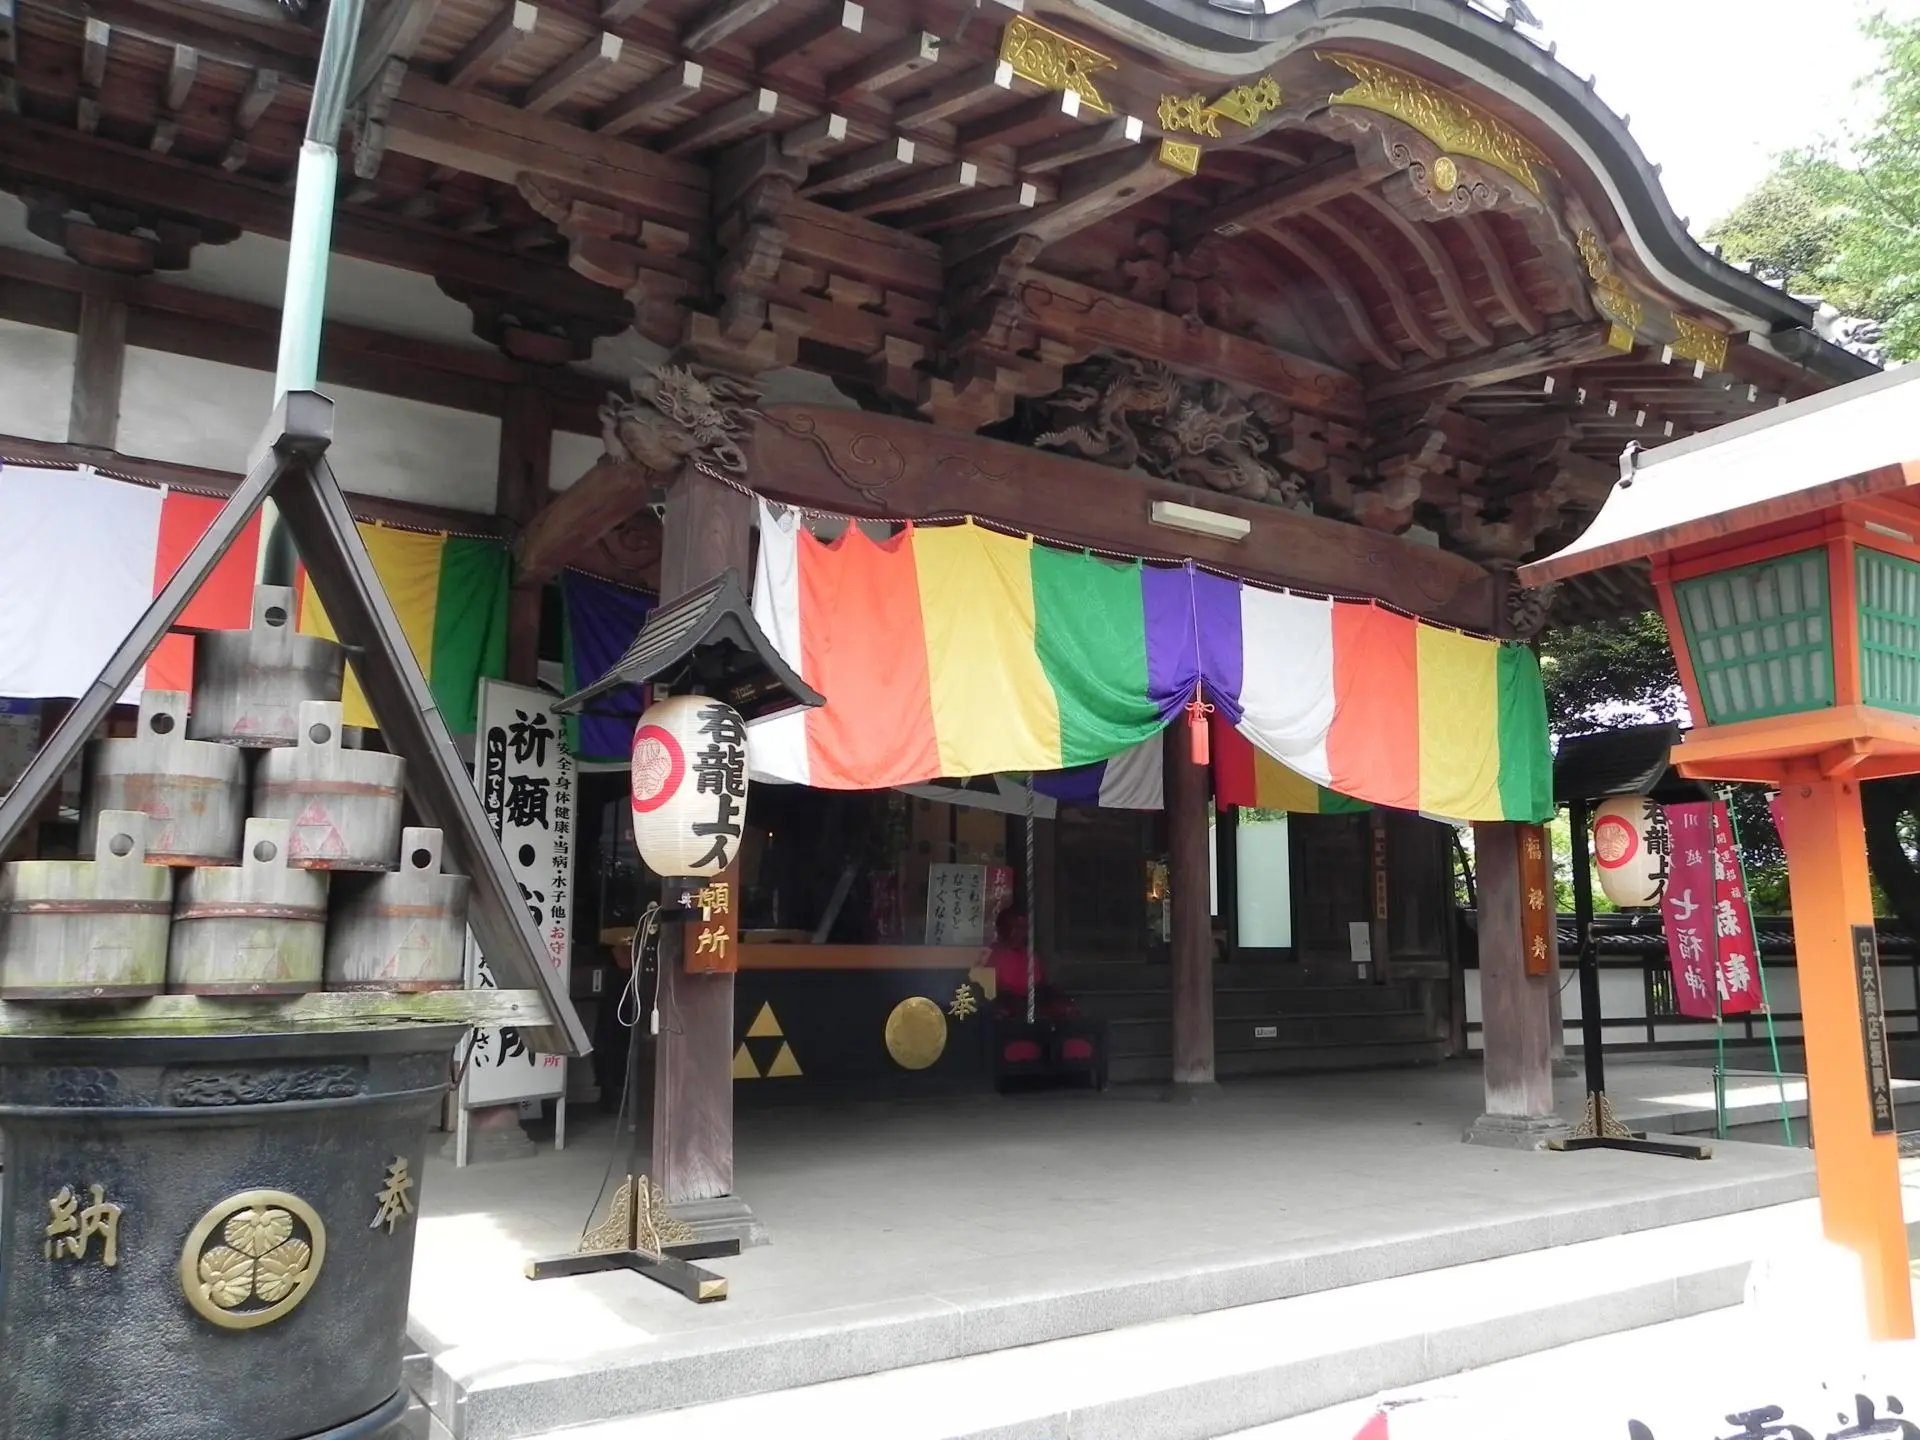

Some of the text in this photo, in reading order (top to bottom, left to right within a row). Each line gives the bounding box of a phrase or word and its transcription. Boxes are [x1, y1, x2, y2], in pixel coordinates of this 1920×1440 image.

[688, 704, 748, 869] 呑龍上人
[1525, 838, 1548, 960] 福禄寿
[948, 983, 977, 1020] 奉
[45, 1184, 123, 1267] 納
[369, 1156, 414, 1235] 奉
